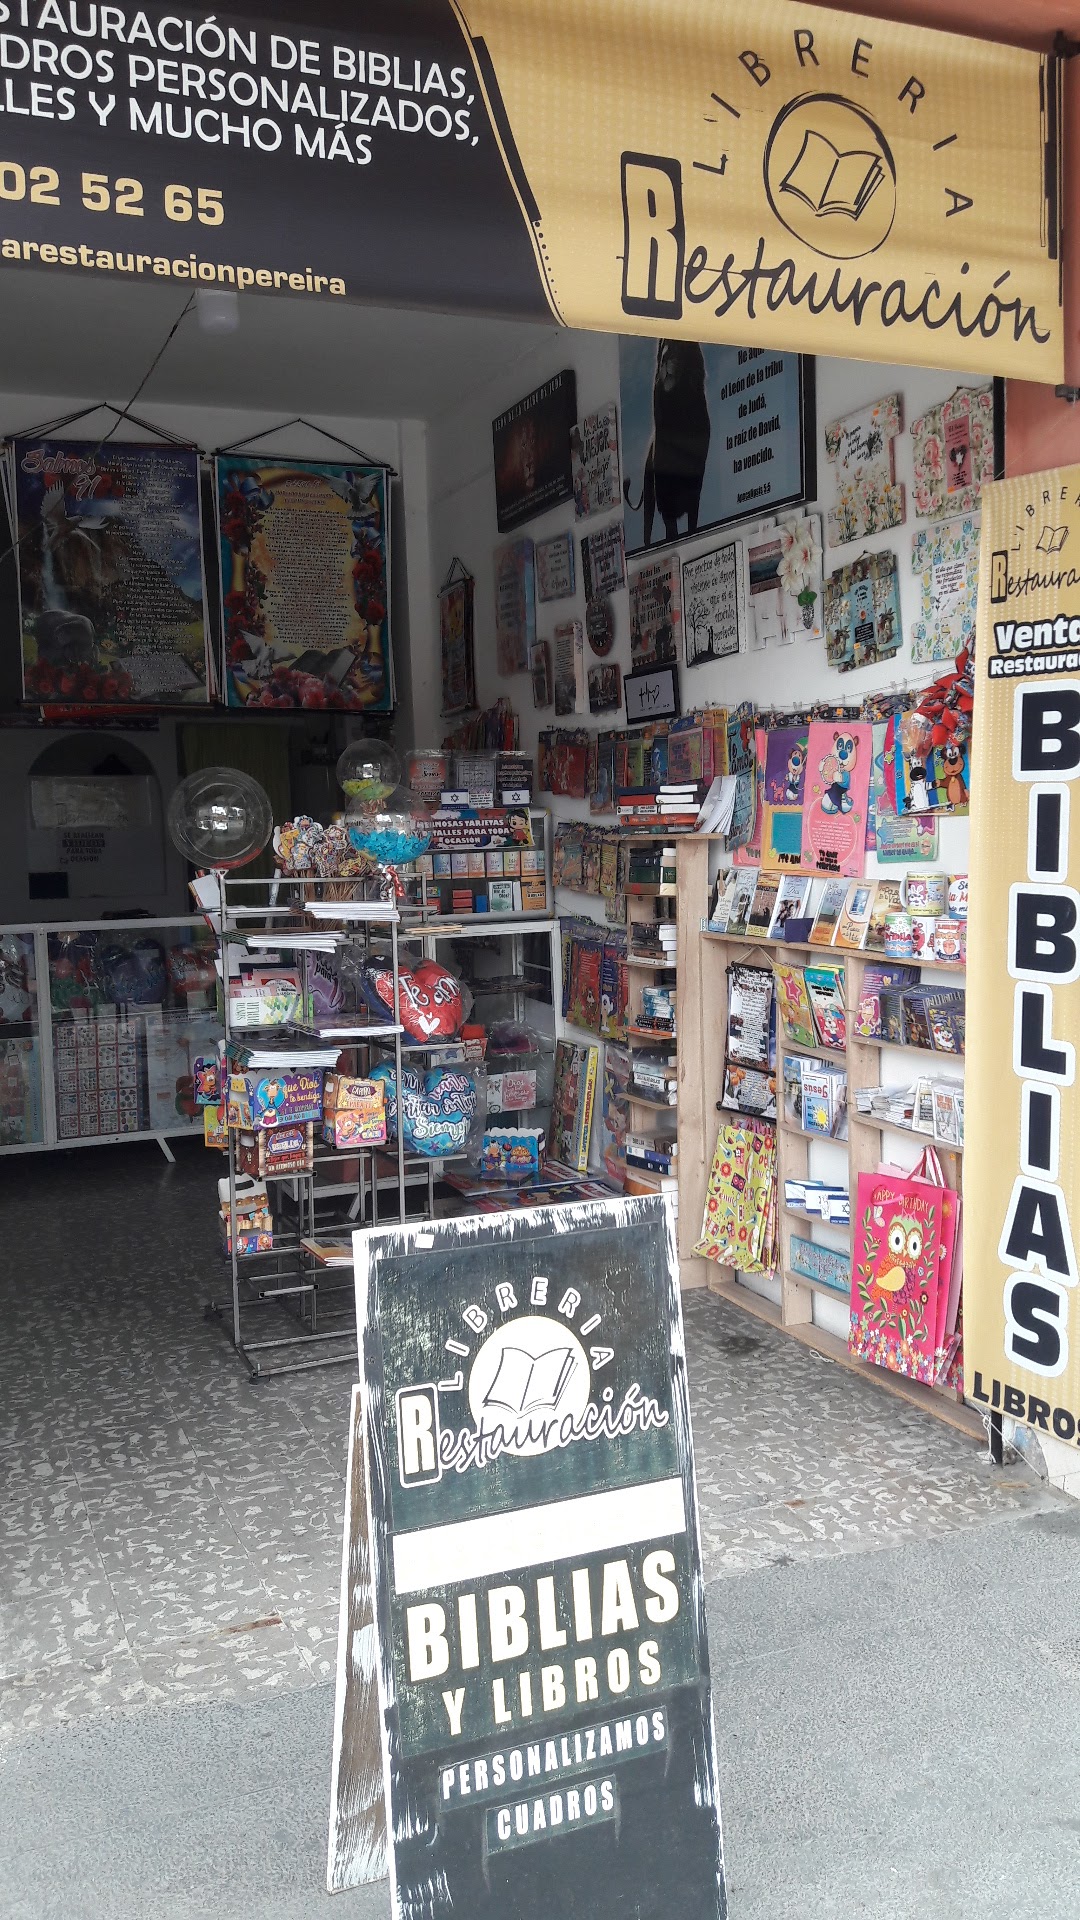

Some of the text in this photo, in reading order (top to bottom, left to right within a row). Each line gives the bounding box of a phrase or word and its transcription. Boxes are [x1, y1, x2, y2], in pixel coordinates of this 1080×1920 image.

[129, 54, 480, 147] PERSONALIZADOS,
[270, 35, 321, 77] DE
[333, 44, 476, 106] BIBLIAS,
[0, 78, 373, 166] LES Y MUCHO MÁS
[692, 28, 974, 218] LIBRERIA
[0, 161, 226, 227] 02 52 65
[620, 150, 1052, 345] Restauración
[721, 359, 784, 401] el León de la tribu
[737, 350, 748, 366] He
[726, 435, 734, 451] la
[748, 425, 758, 441] de
[738, 403, 748, 419] de
[733, 446, 775, 474] ha vencido.
[463, 828, 487, 836] PARA
[488, 827, 510, 835] TODA
[1003, 686, 1080, 1370] BIBLIAS
[282, 1077, 320, 1099] que Dios
[438, 1277, 614, 1392] LIBRERIA
[395, 1382, 669, 1489] Restauración
[972, 1370, 1080, 1445] LIBRO
[406, 1550, 679, 1683] BIBLIAS
[442, 1640, 662, 1737] Y LIBROS
[442, 1711, 665, 1800] PERSONALIZAMOS
[497, 1781, 615, 1841] CUADROS
